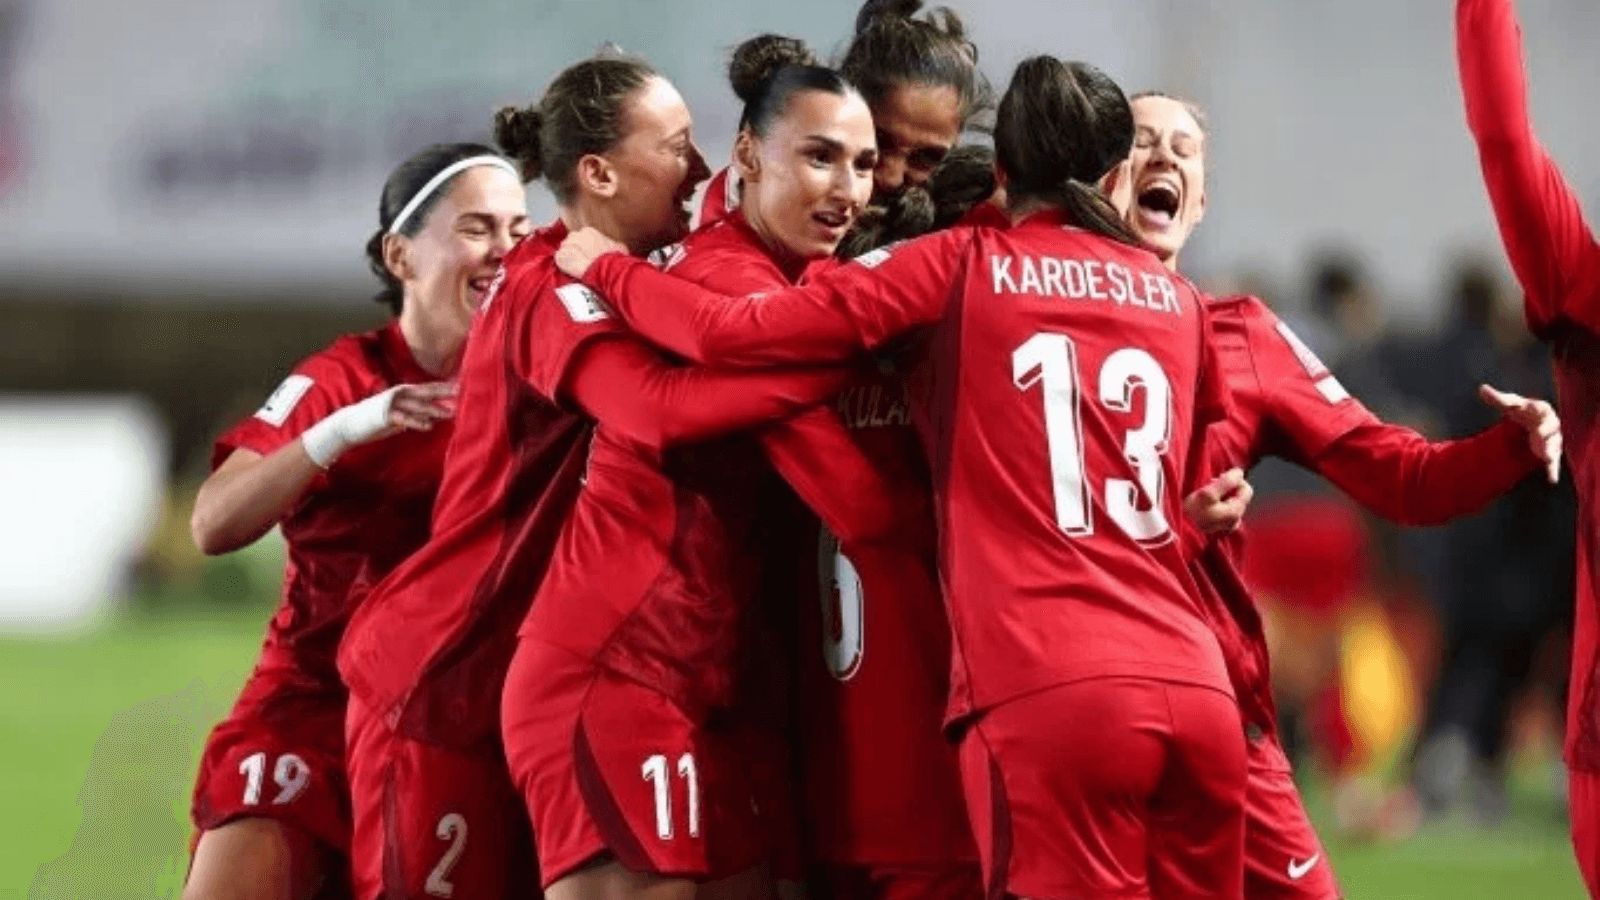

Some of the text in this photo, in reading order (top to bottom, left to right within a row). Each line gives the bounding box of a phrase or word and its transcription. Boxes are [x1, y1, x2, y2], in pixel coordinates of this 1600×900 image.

[1011, 331, 1177, 549] 13
[239, 751, 311, 805] 19
[642, 752, 699, 840] 11
[424, 813, 468, 899] 2
